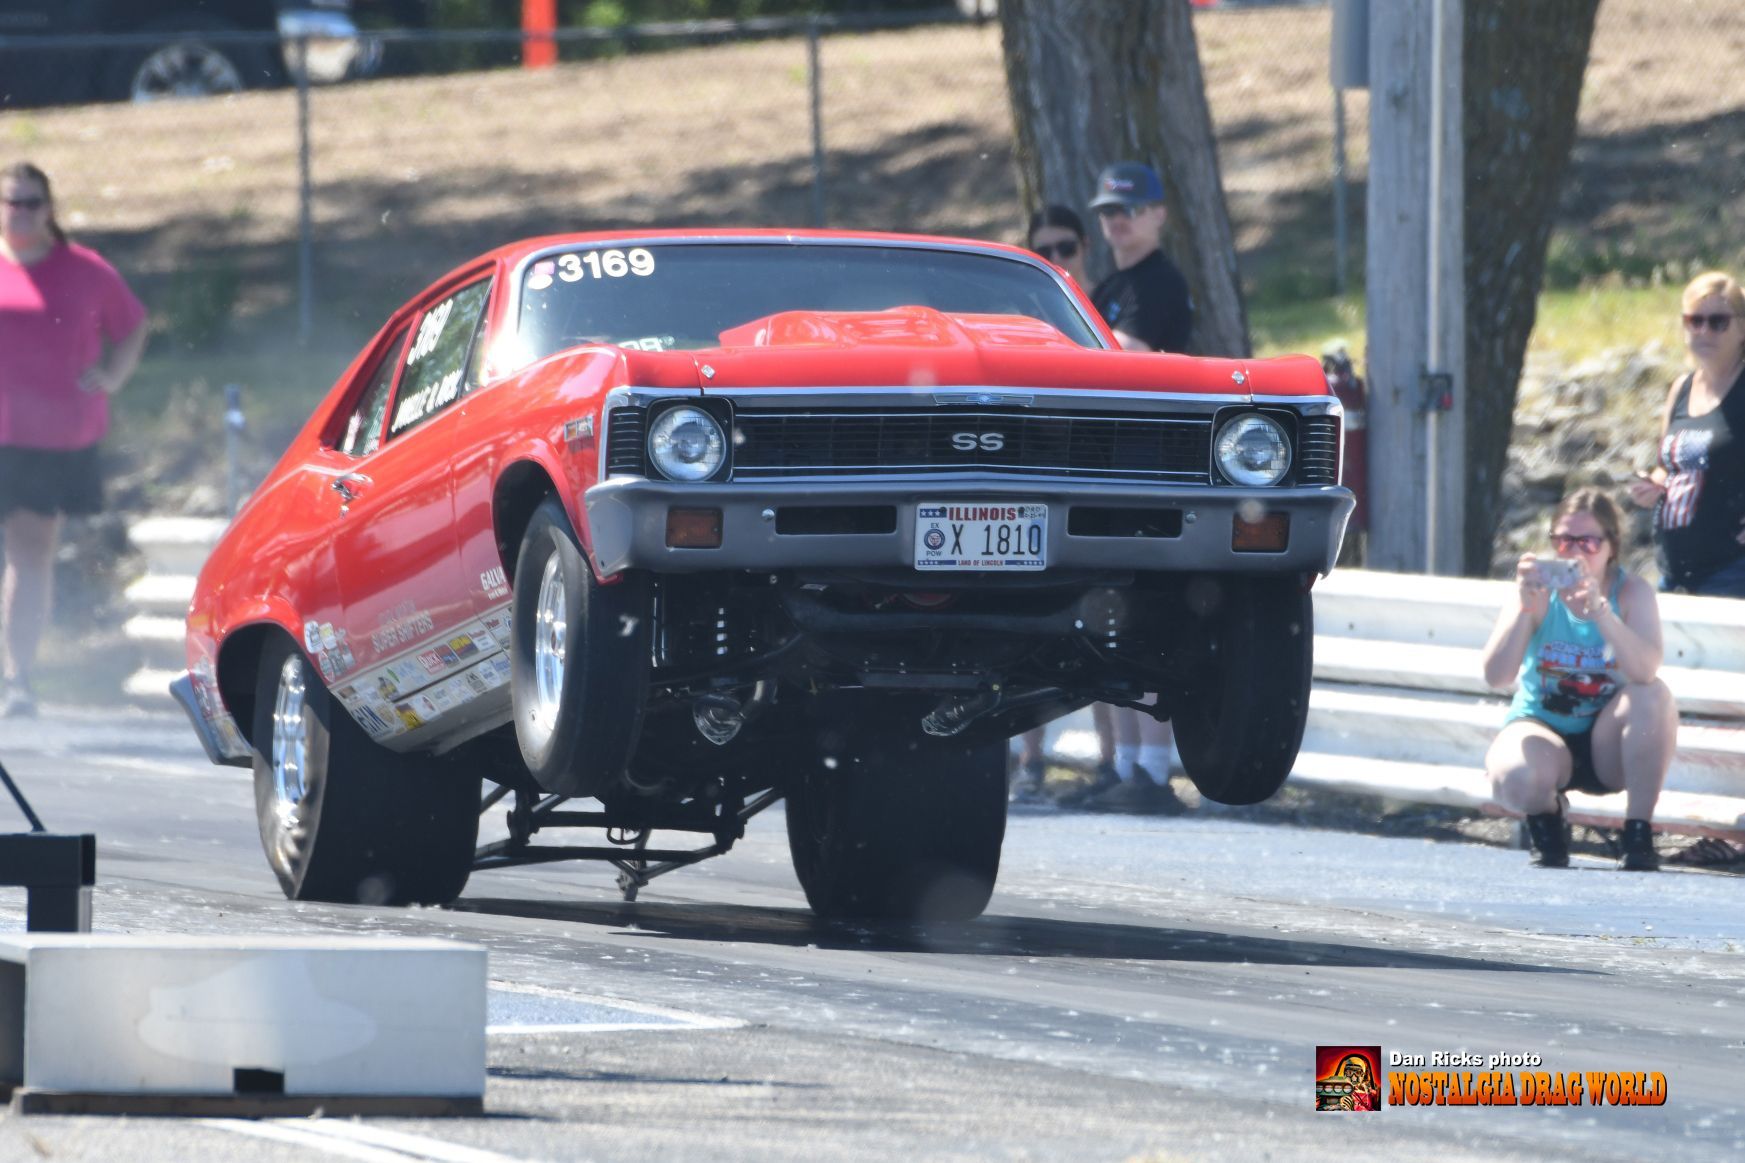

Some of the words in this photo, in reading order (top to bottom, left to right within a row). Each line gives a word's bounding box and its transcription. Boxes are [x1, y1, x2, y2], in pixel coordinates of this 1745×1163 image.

[558, 248, 655, 282] 3169
[952, 432, 1005, 451] SS
[948, 507, 1016, 521] ILLINOIS
[951, 524, 964, 555] X
[981, 524, 1041, 555] 1810
